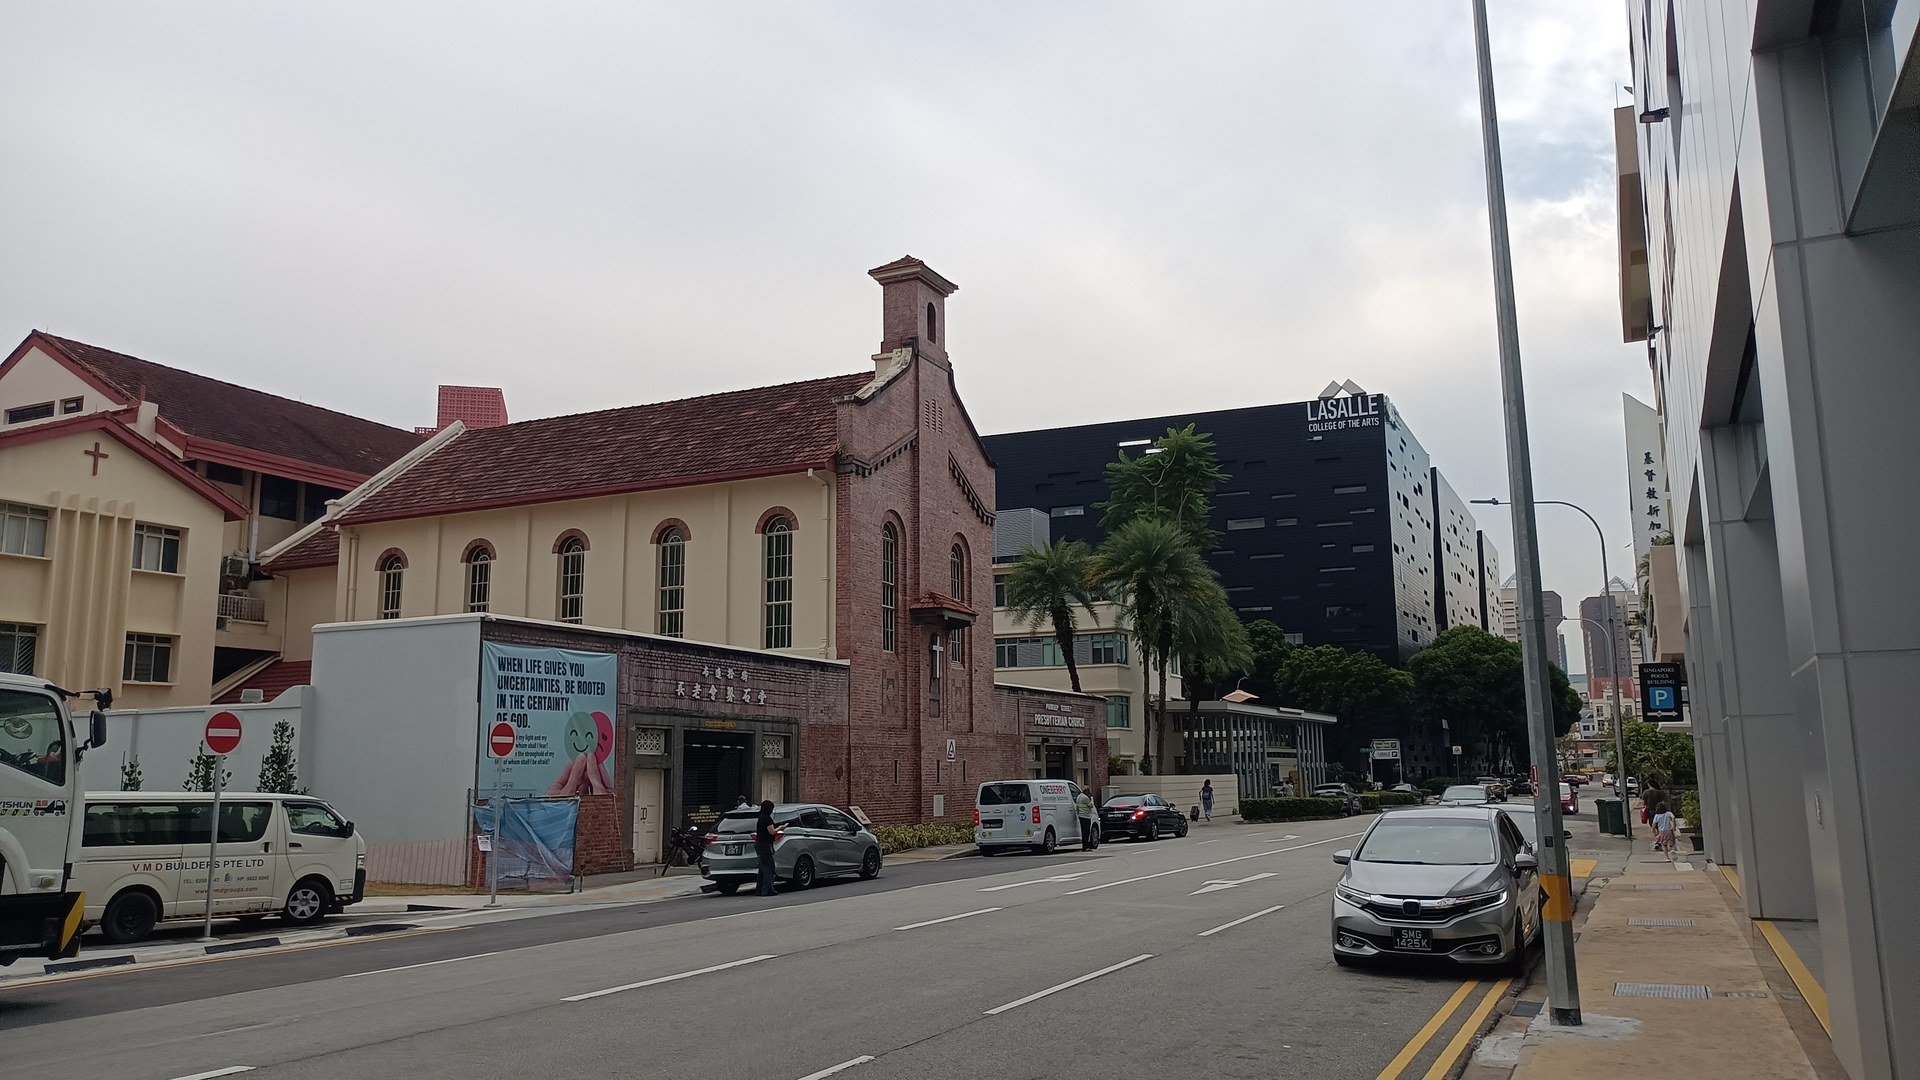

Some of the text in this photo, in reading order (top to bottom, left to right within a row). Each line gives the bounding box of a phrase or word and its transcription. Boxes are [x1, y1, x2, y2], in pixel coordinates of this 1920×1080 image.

[1307, 395, 1379, 421] LASALLE
[1308, 417, 1380, 432] COLLEGE OF THE ARTS
[1644, 451, 1662, 546] 基督教新加
[498, 656, 585, 678] WHEN LIFE GIVES YOU
[497, 675, 606, 696] UNCERTAINTIES, BE ROOTED
[496, 693, 570, 711] IN THE CERTAINTY
[1655, 689, 1668, 706] P
[1034, 713, 1085, 728] PRESBYTERIAN CHURCH
[1040, 785, 1066, 794] ONEBERRY
[143, 863, 152, 871] M
[223, 859, 242, 868] PTE
[245, 859, 264, 868] LTD
[1401, 929, 1422, 939] SMG
[1396, 938, 1428, 948] 1425K
